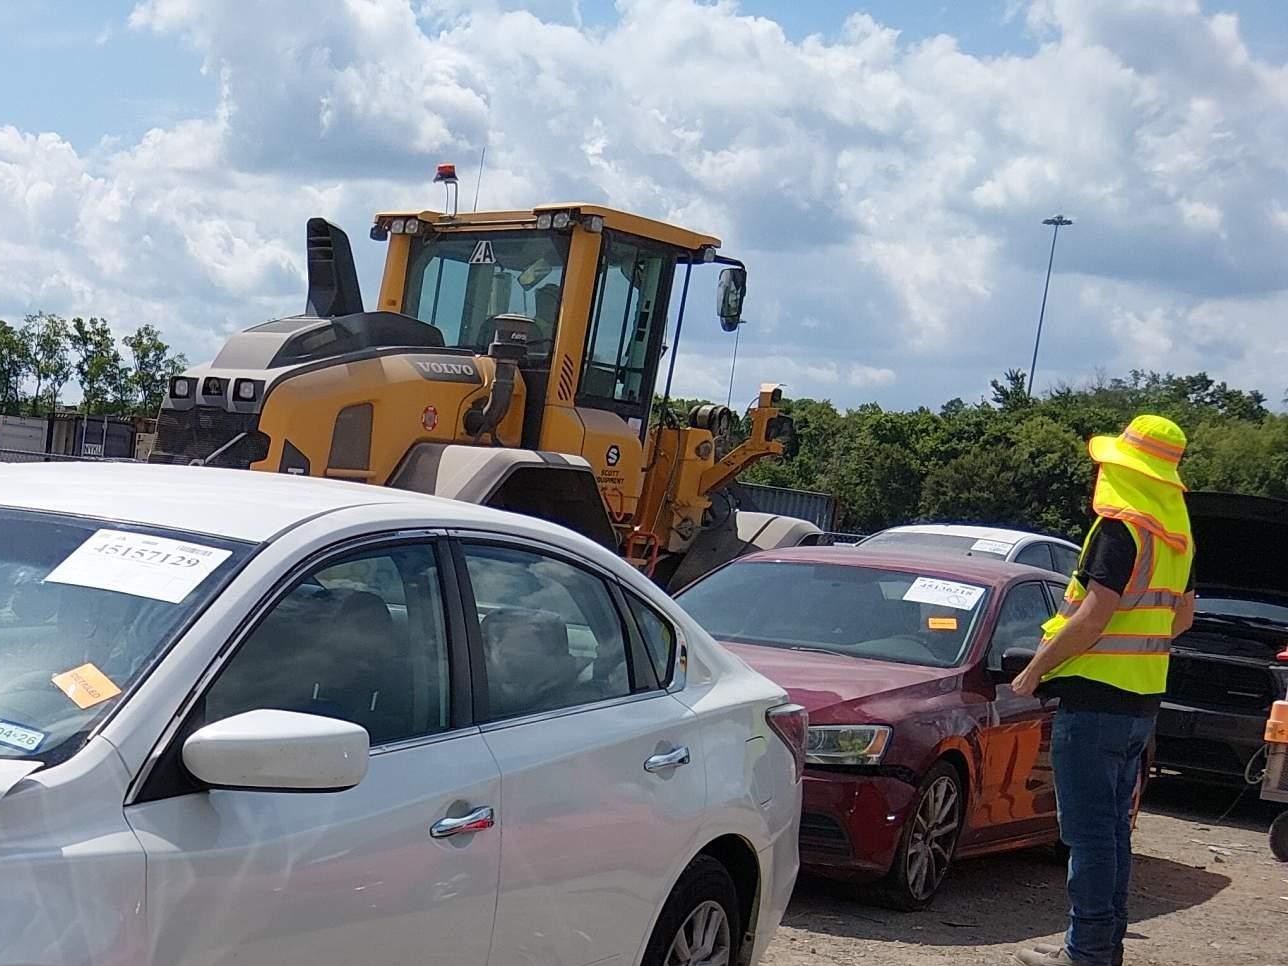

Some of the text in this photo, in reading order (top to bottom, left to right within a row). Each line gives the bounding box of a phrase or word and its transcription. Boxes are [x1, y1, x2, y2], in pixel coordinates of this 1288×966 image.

[417, 361, 474, 376] VOLVO
[601, 469, 620, 477] SCOTT
[94, 543, 201, 568] 45157129
